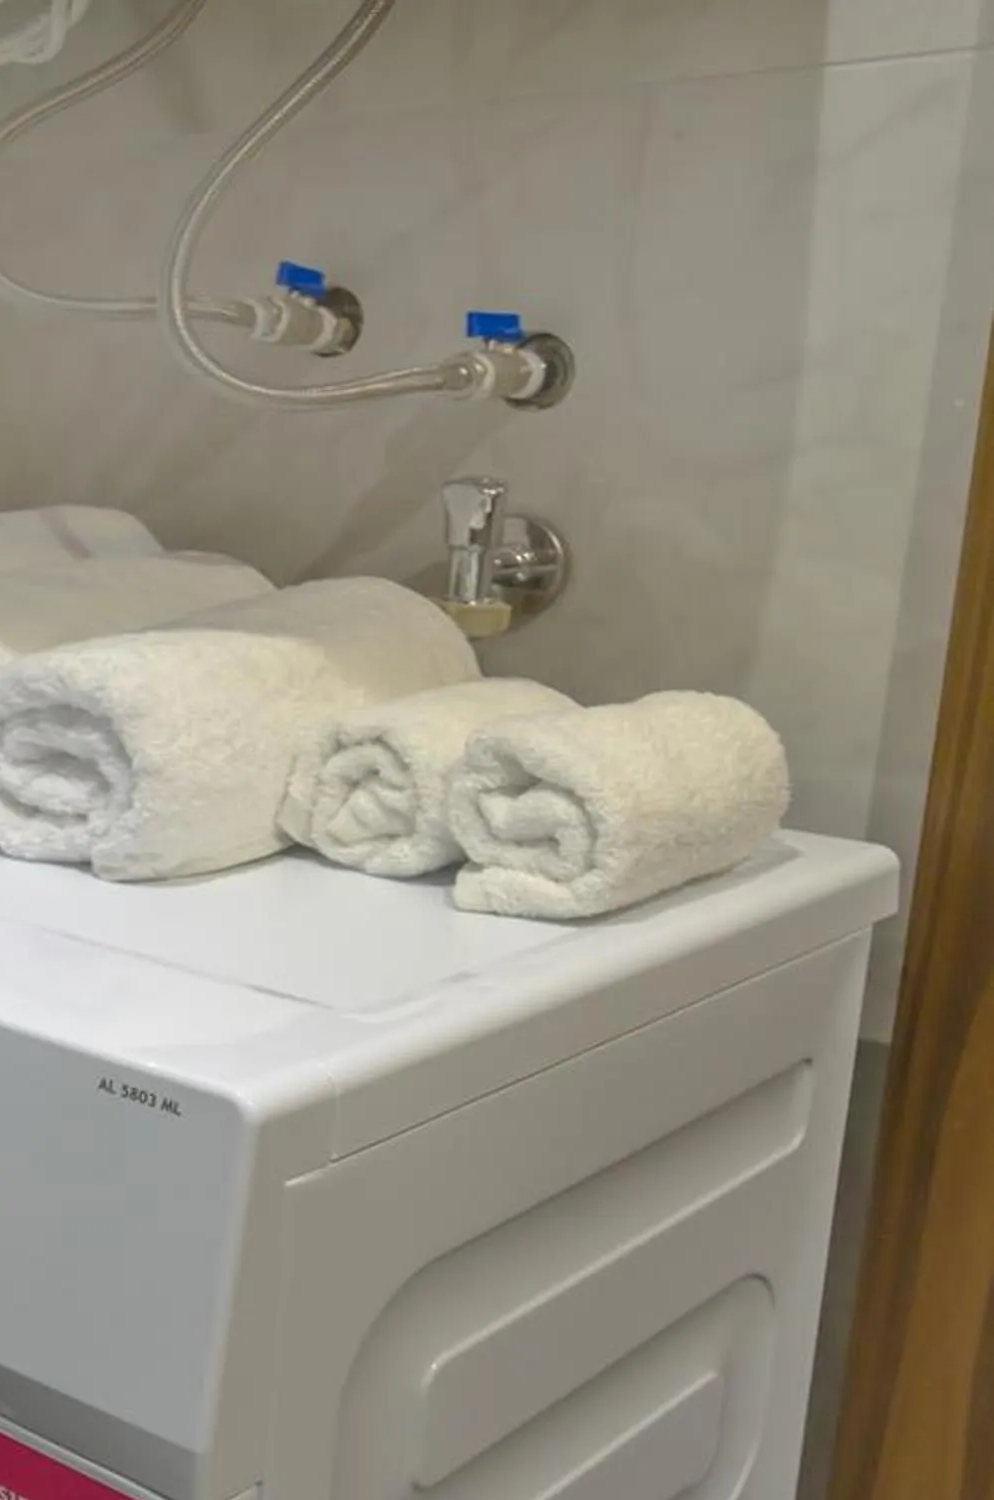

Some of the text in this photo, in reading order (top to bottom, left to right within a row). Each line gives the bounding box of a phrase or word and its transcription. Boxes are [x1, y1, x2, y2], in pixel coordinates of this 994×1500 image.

[98, 1077, 182, 1117] AL 5803 ML
